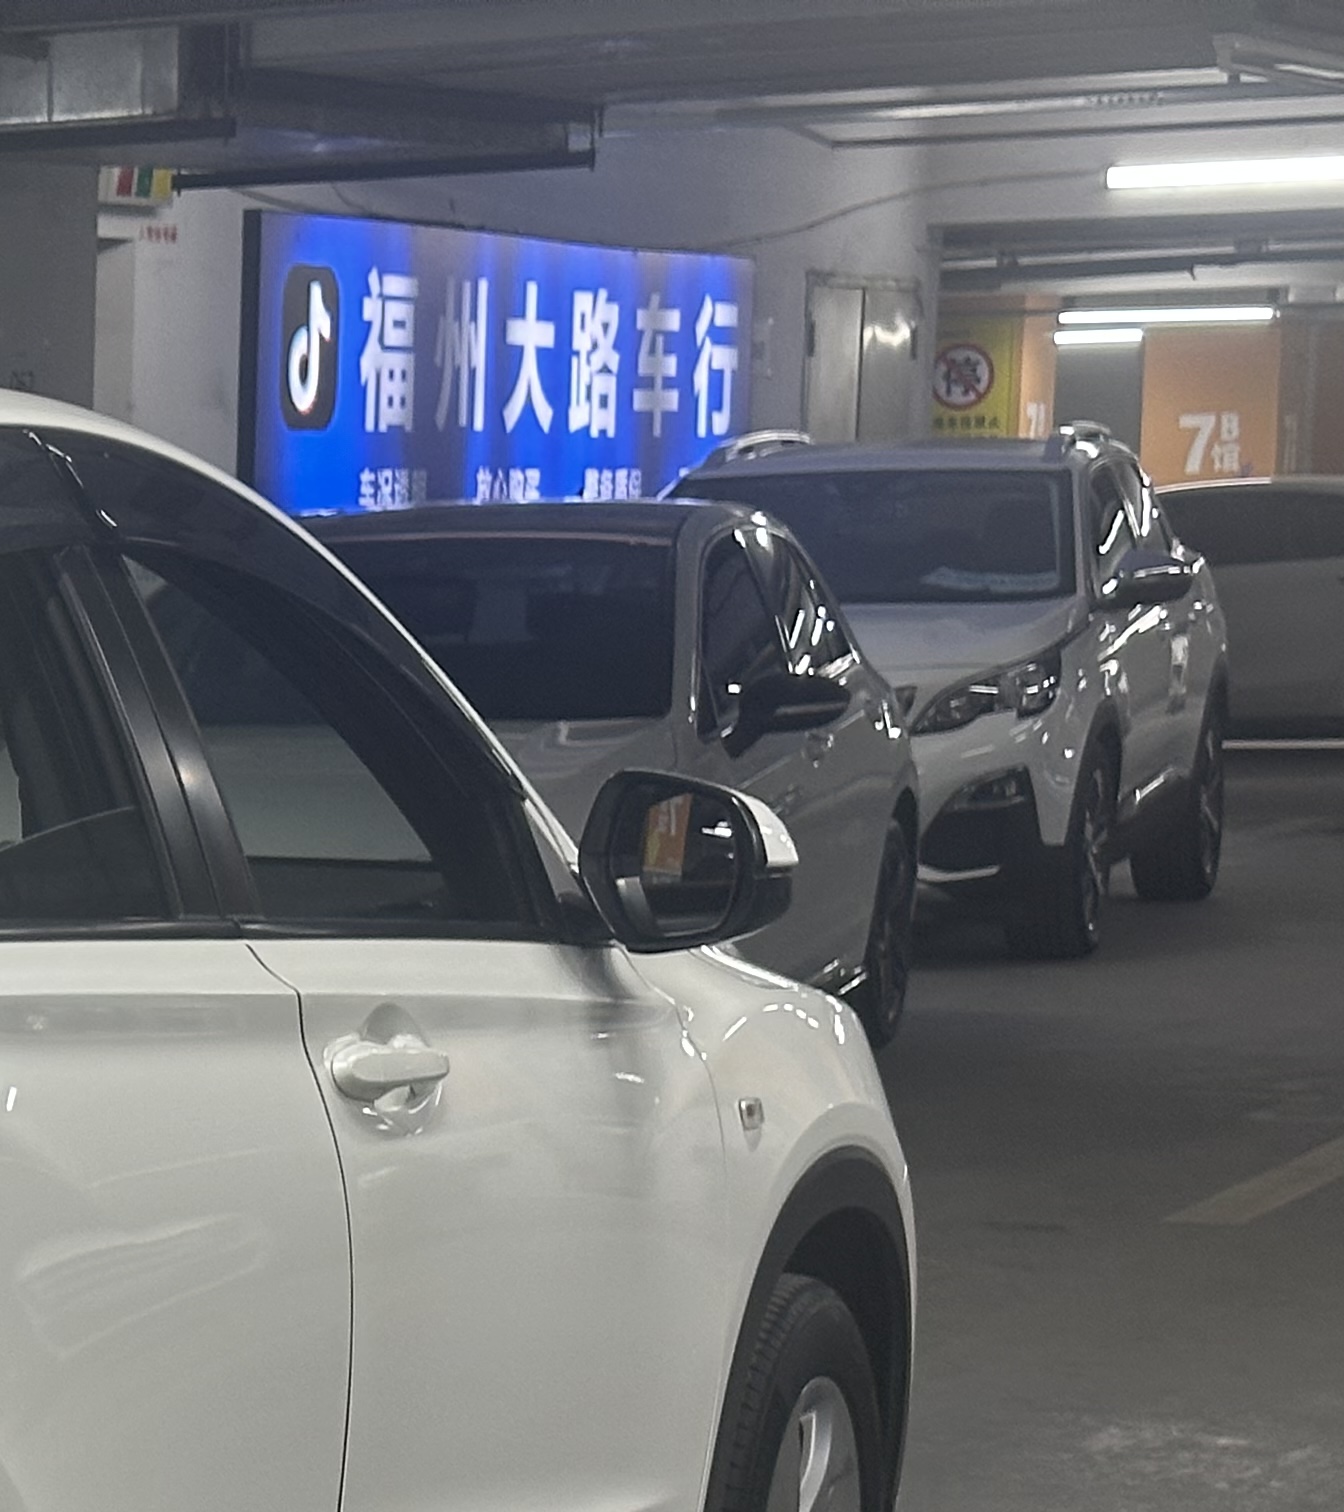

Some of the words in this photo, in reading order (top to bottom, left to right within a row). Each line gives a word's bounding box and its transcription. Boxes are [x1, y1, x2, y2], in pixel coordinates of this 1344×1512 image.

[360, 265, 739, 438] 福州大路车行
